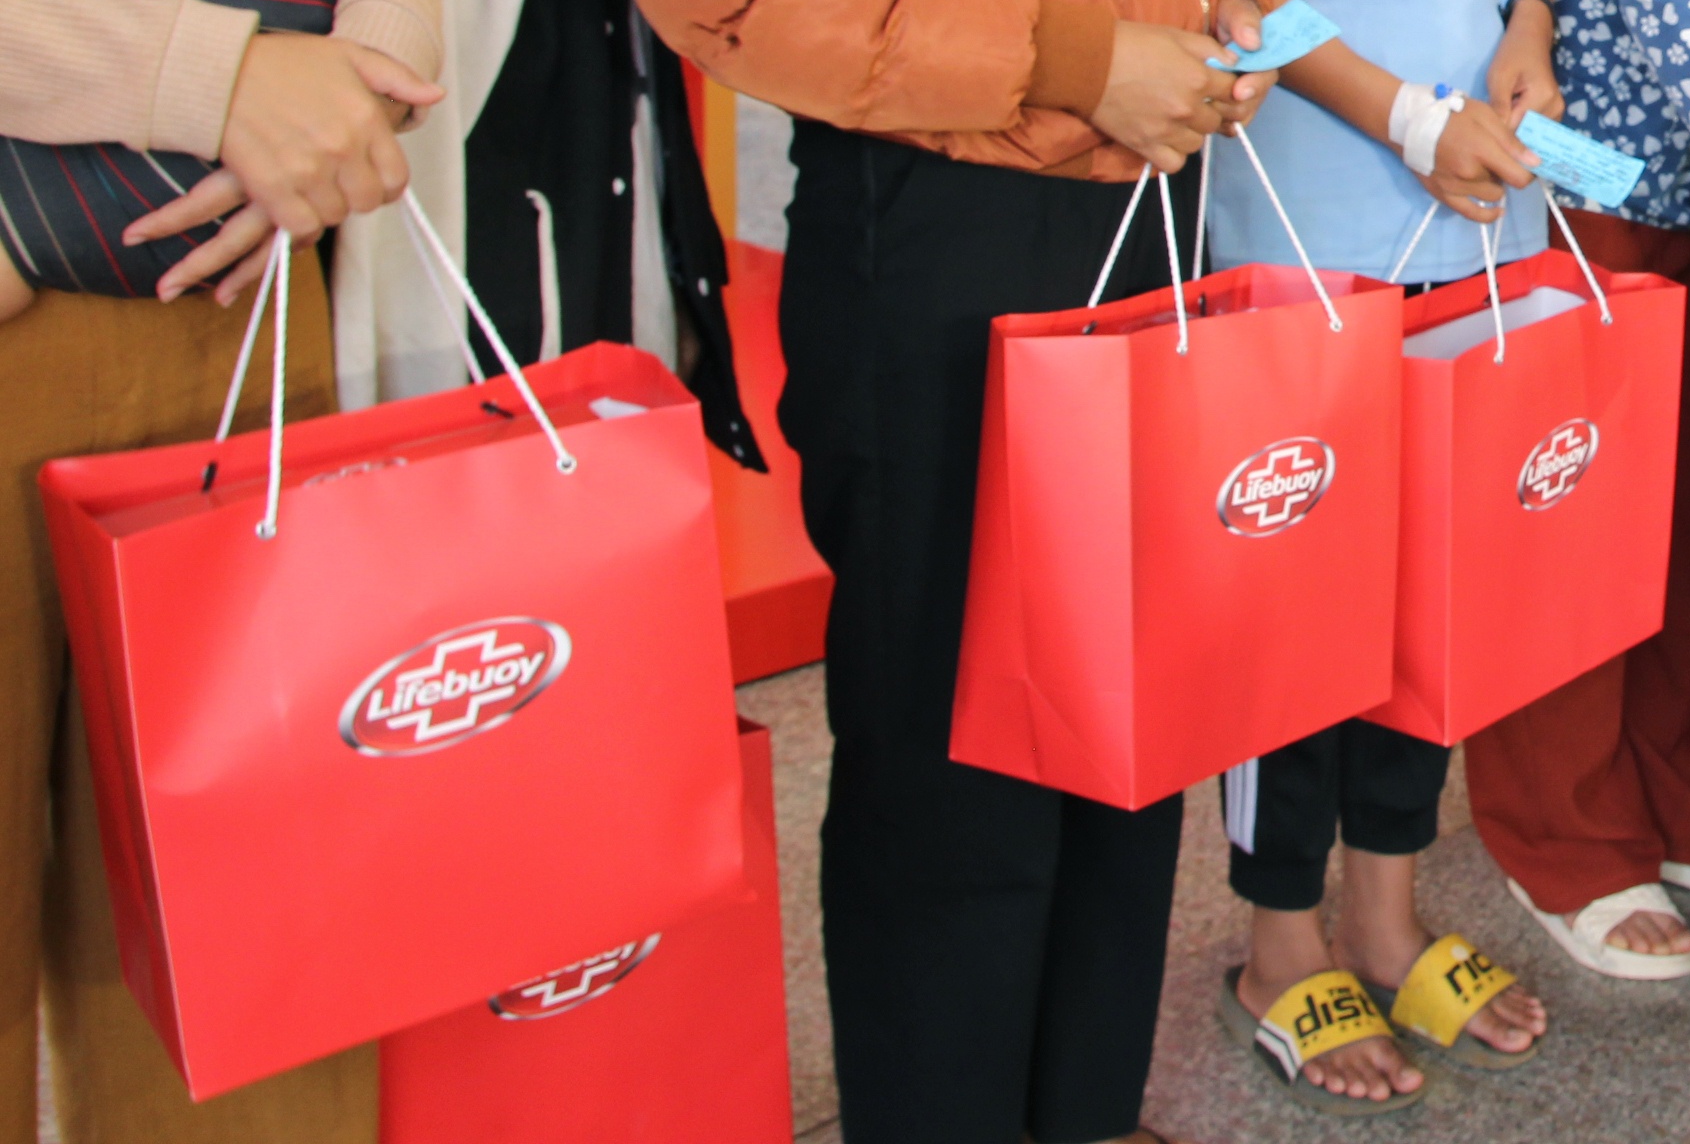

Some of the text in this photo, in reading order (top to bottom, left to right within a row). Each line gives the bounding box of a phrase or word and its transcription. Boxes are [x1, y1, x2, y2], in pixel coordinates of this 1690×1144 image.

[1526, 441, 1590, 486] Lifebuoy
[1231, 466, 1324, 507] Lifebuoy
[366, 651, 546, 723] Lifebuoy
